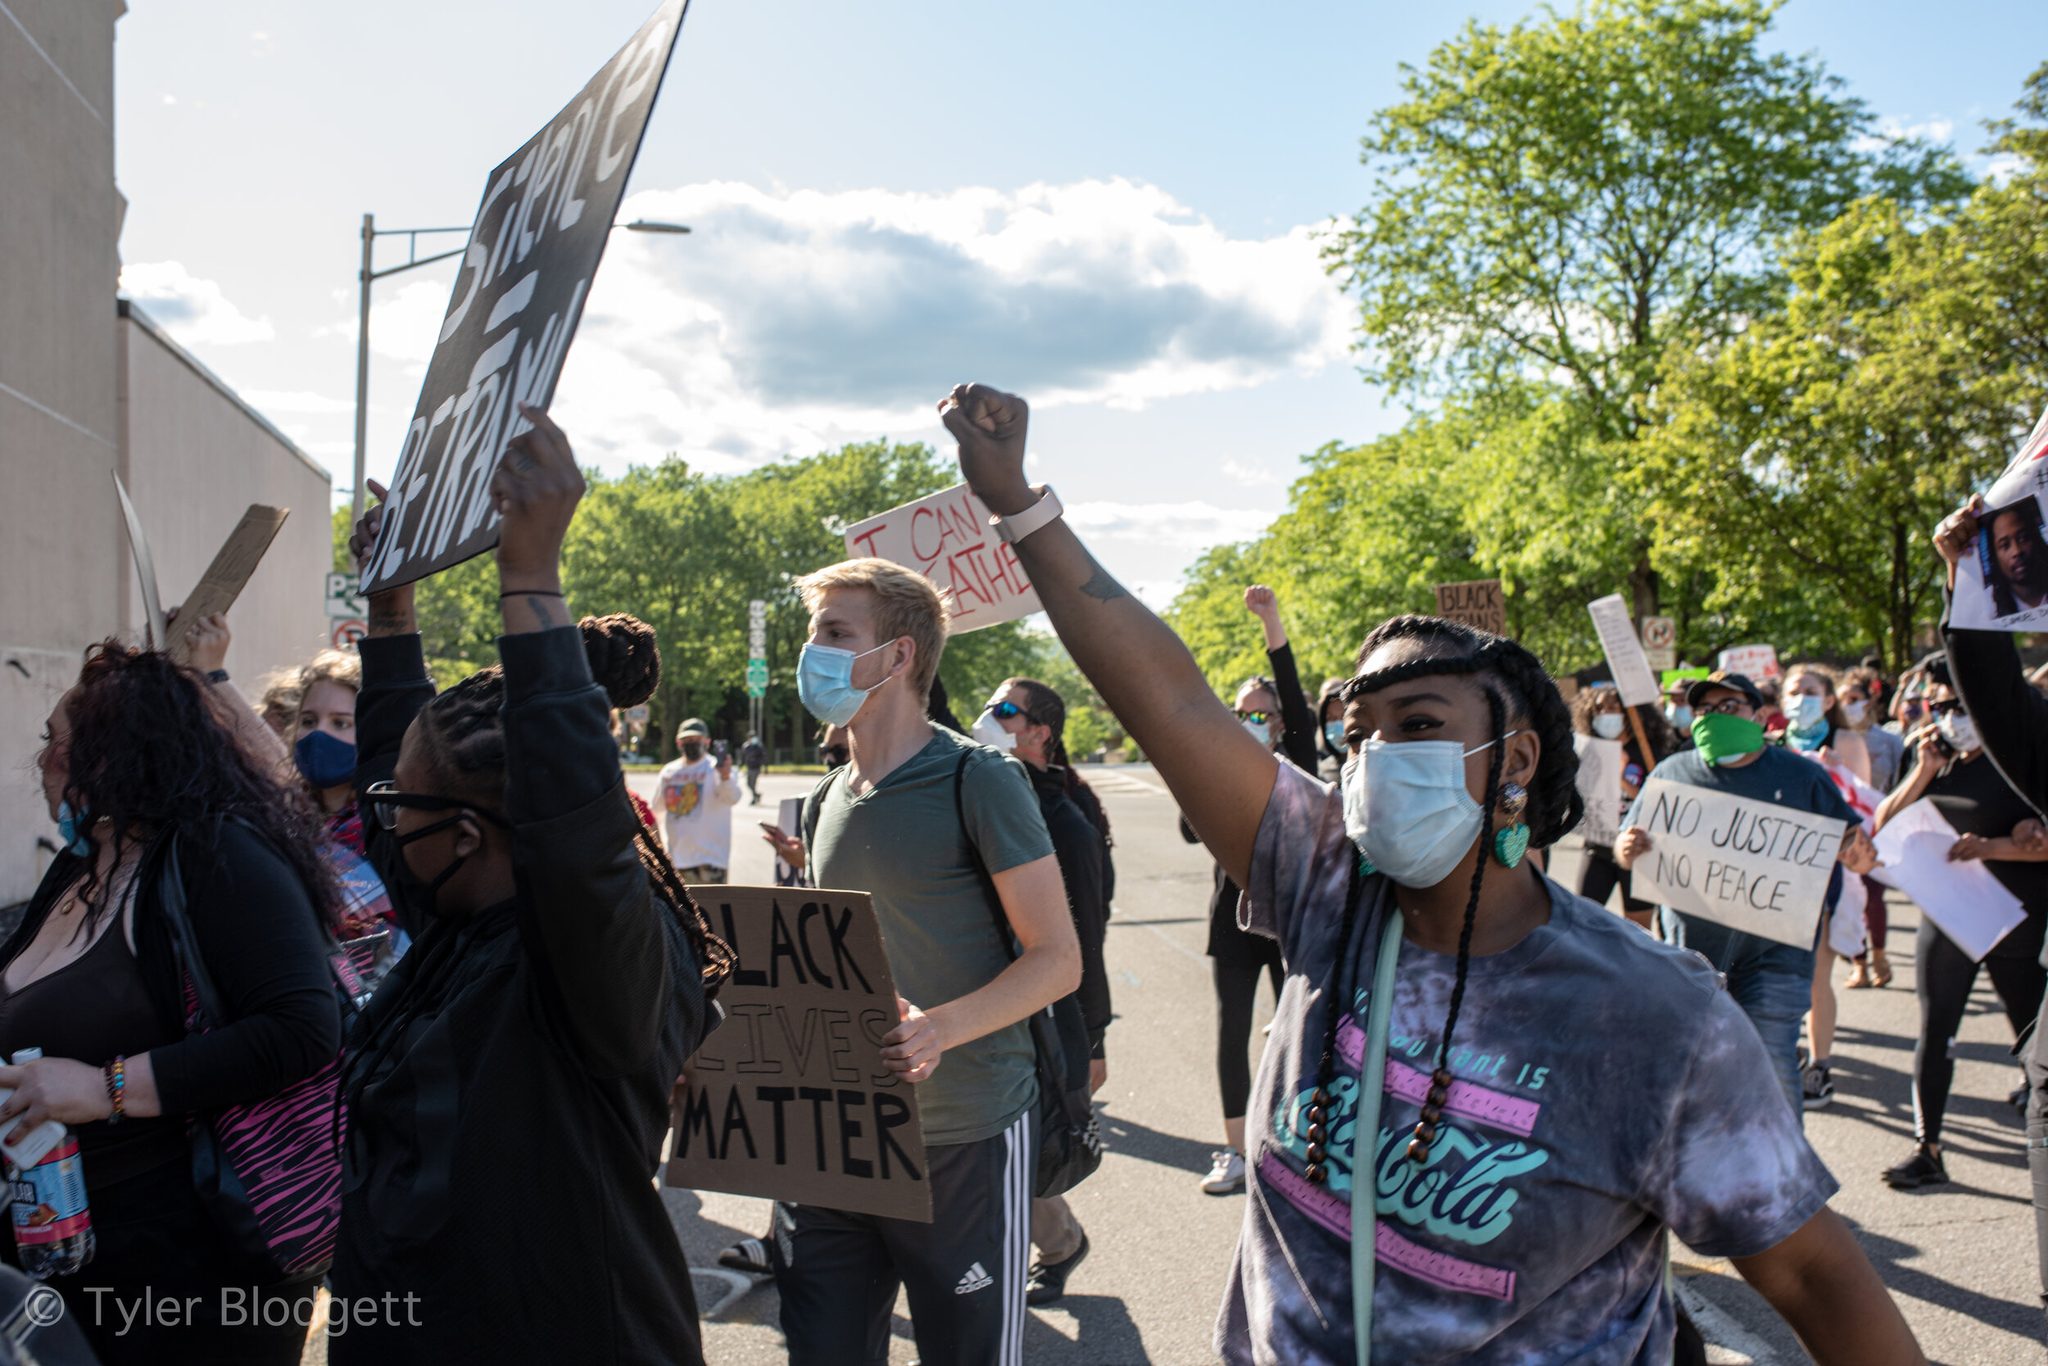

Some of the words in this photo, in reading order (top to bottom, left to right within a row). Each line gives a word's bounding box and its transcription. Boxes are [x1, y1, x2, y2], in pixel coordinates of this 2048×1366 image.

[437, 18, 669, 345] Silence
[911, 493, 981, 562] CAN
[1440, 585, 1500, 611] BLACK
[1444, 611, 1501, 634] RANS
[1648, 791, 1702, 839] NO
[1711, 806, 1841, 871] JUSTICE
[1656, 851, 1692, 889] NO
[1704, 859, 1792, 912] PEACE
[676, 1084, 923, 1182] MATTER
[954, 1275, 994, 1296] adidas
